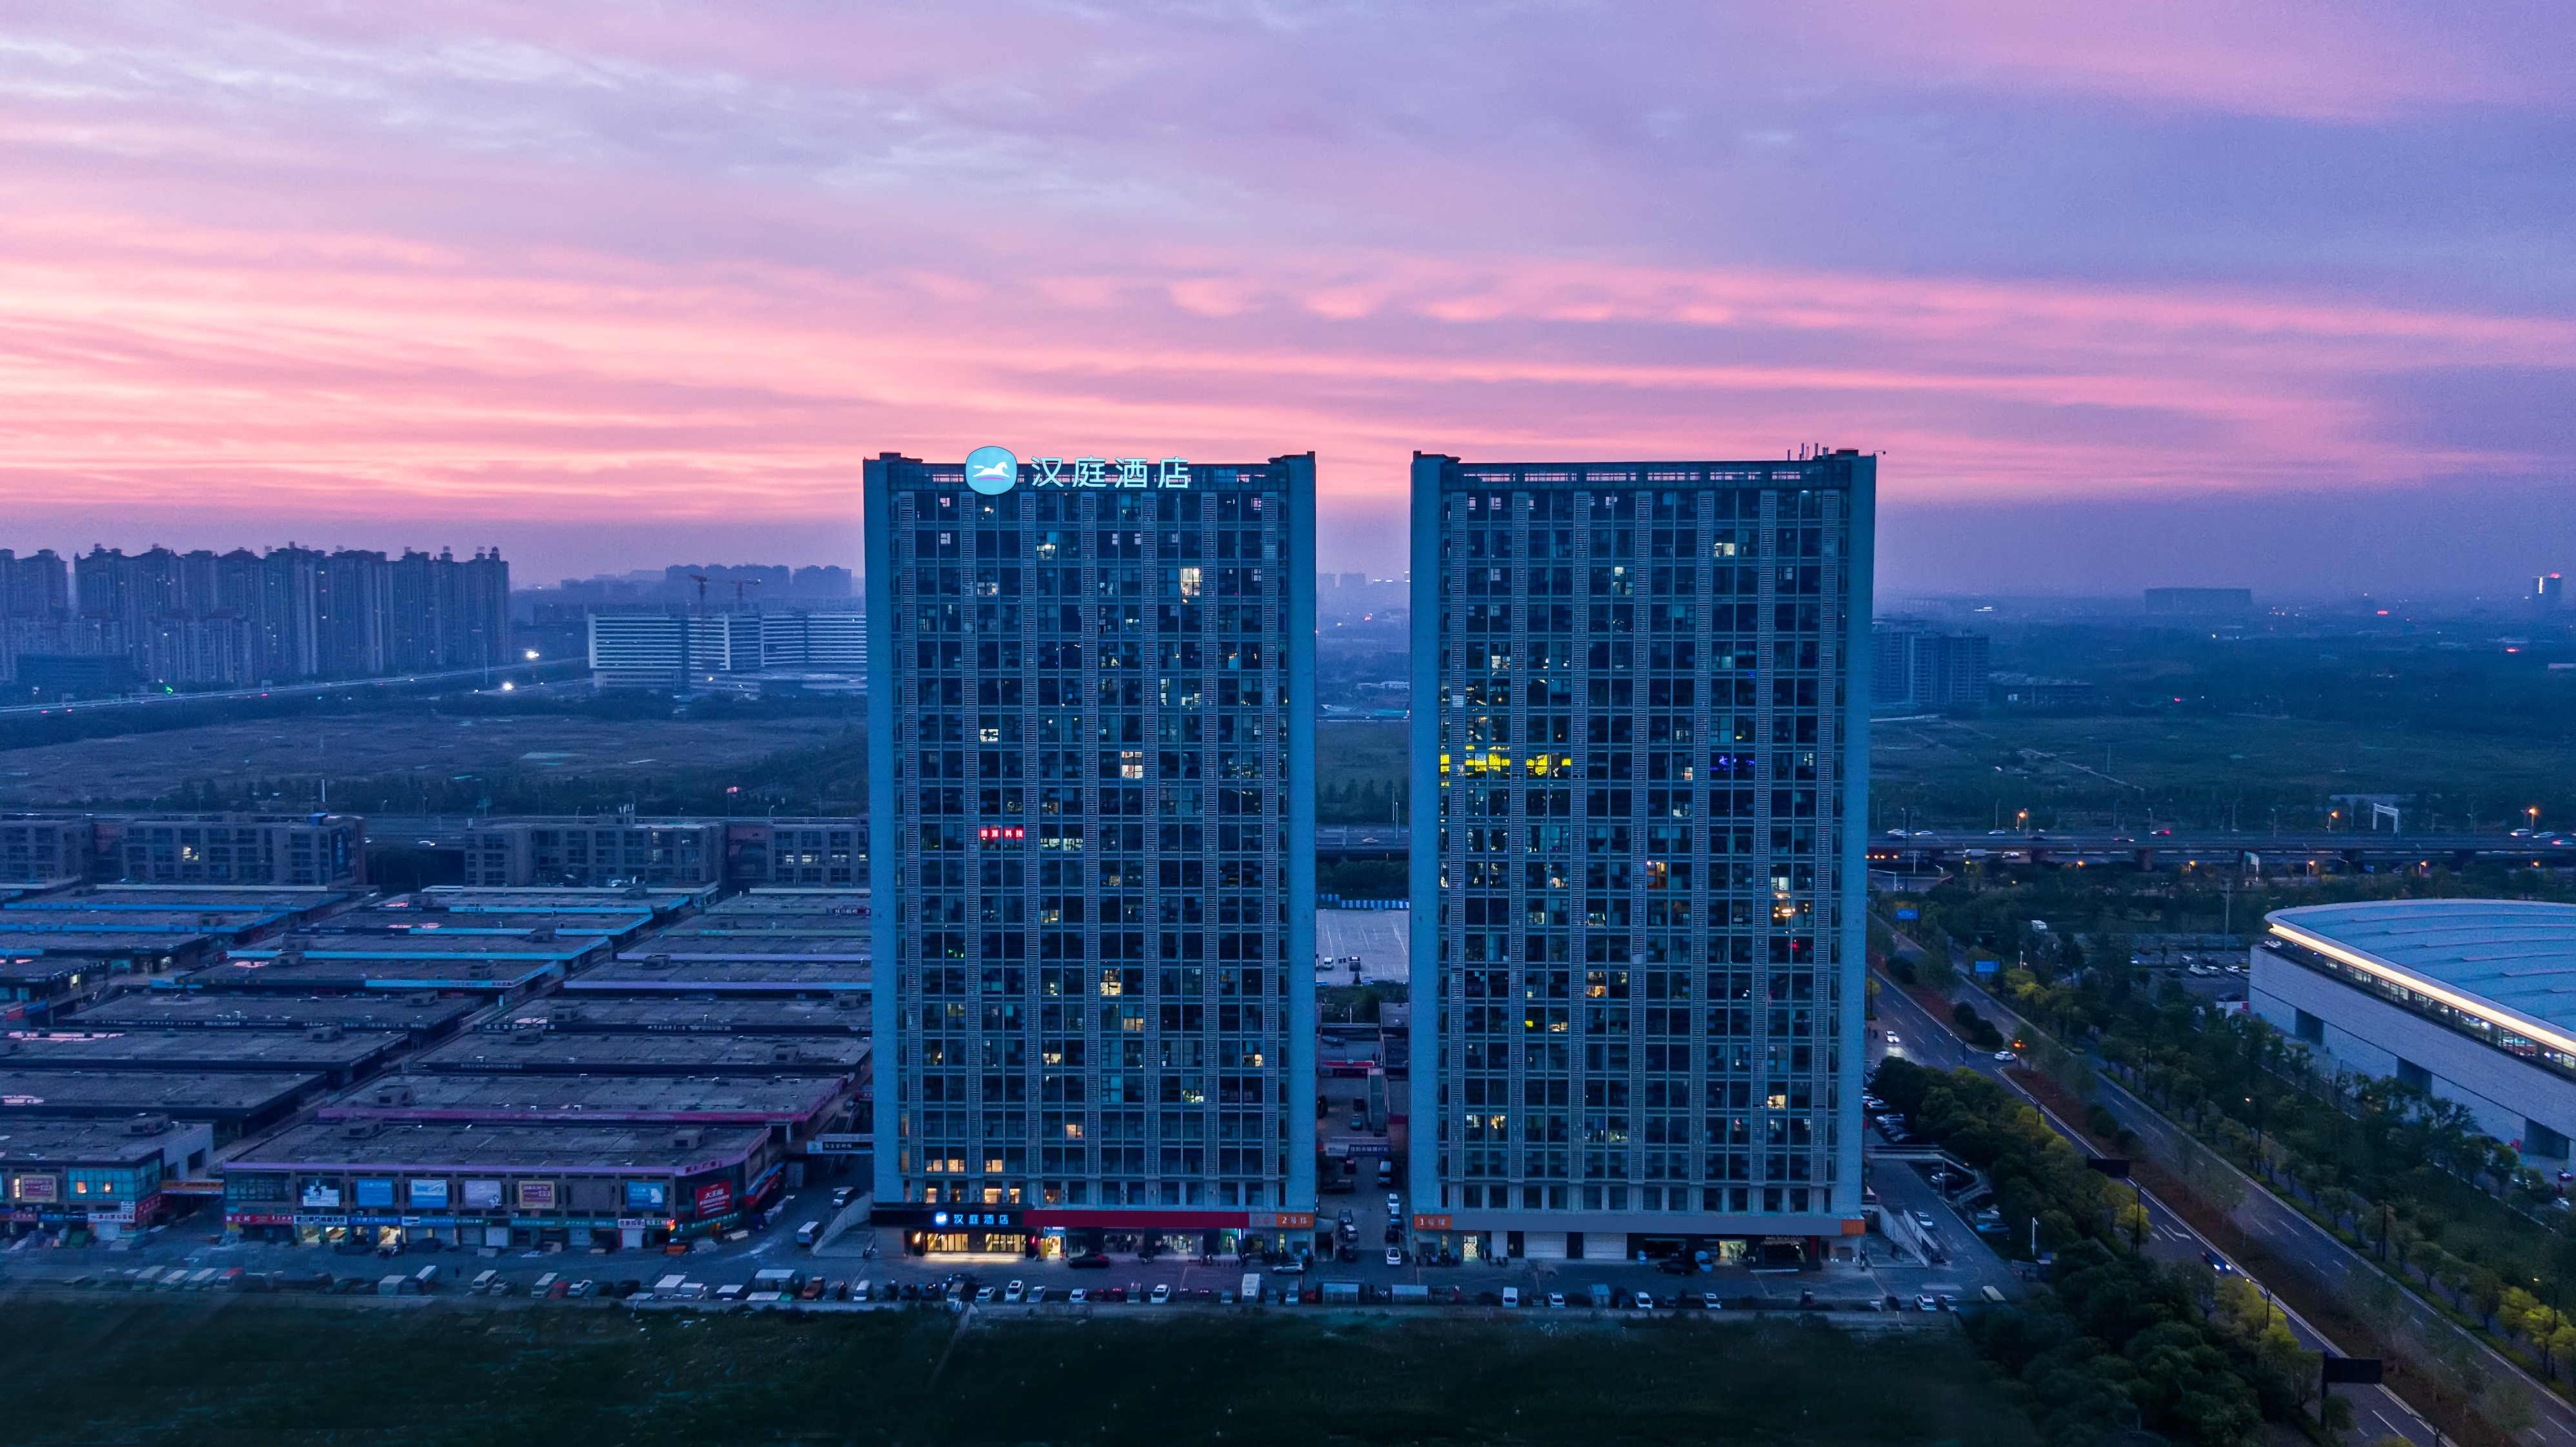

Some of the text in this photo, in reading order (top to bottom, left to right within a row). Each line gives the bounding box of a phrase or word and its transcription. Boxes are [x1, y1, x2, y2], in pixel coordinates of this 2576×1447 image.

[1031, 455, 1189, 489] 汉庭酒店
[953, 1214, 1009, 1225] 汉庭酒店
